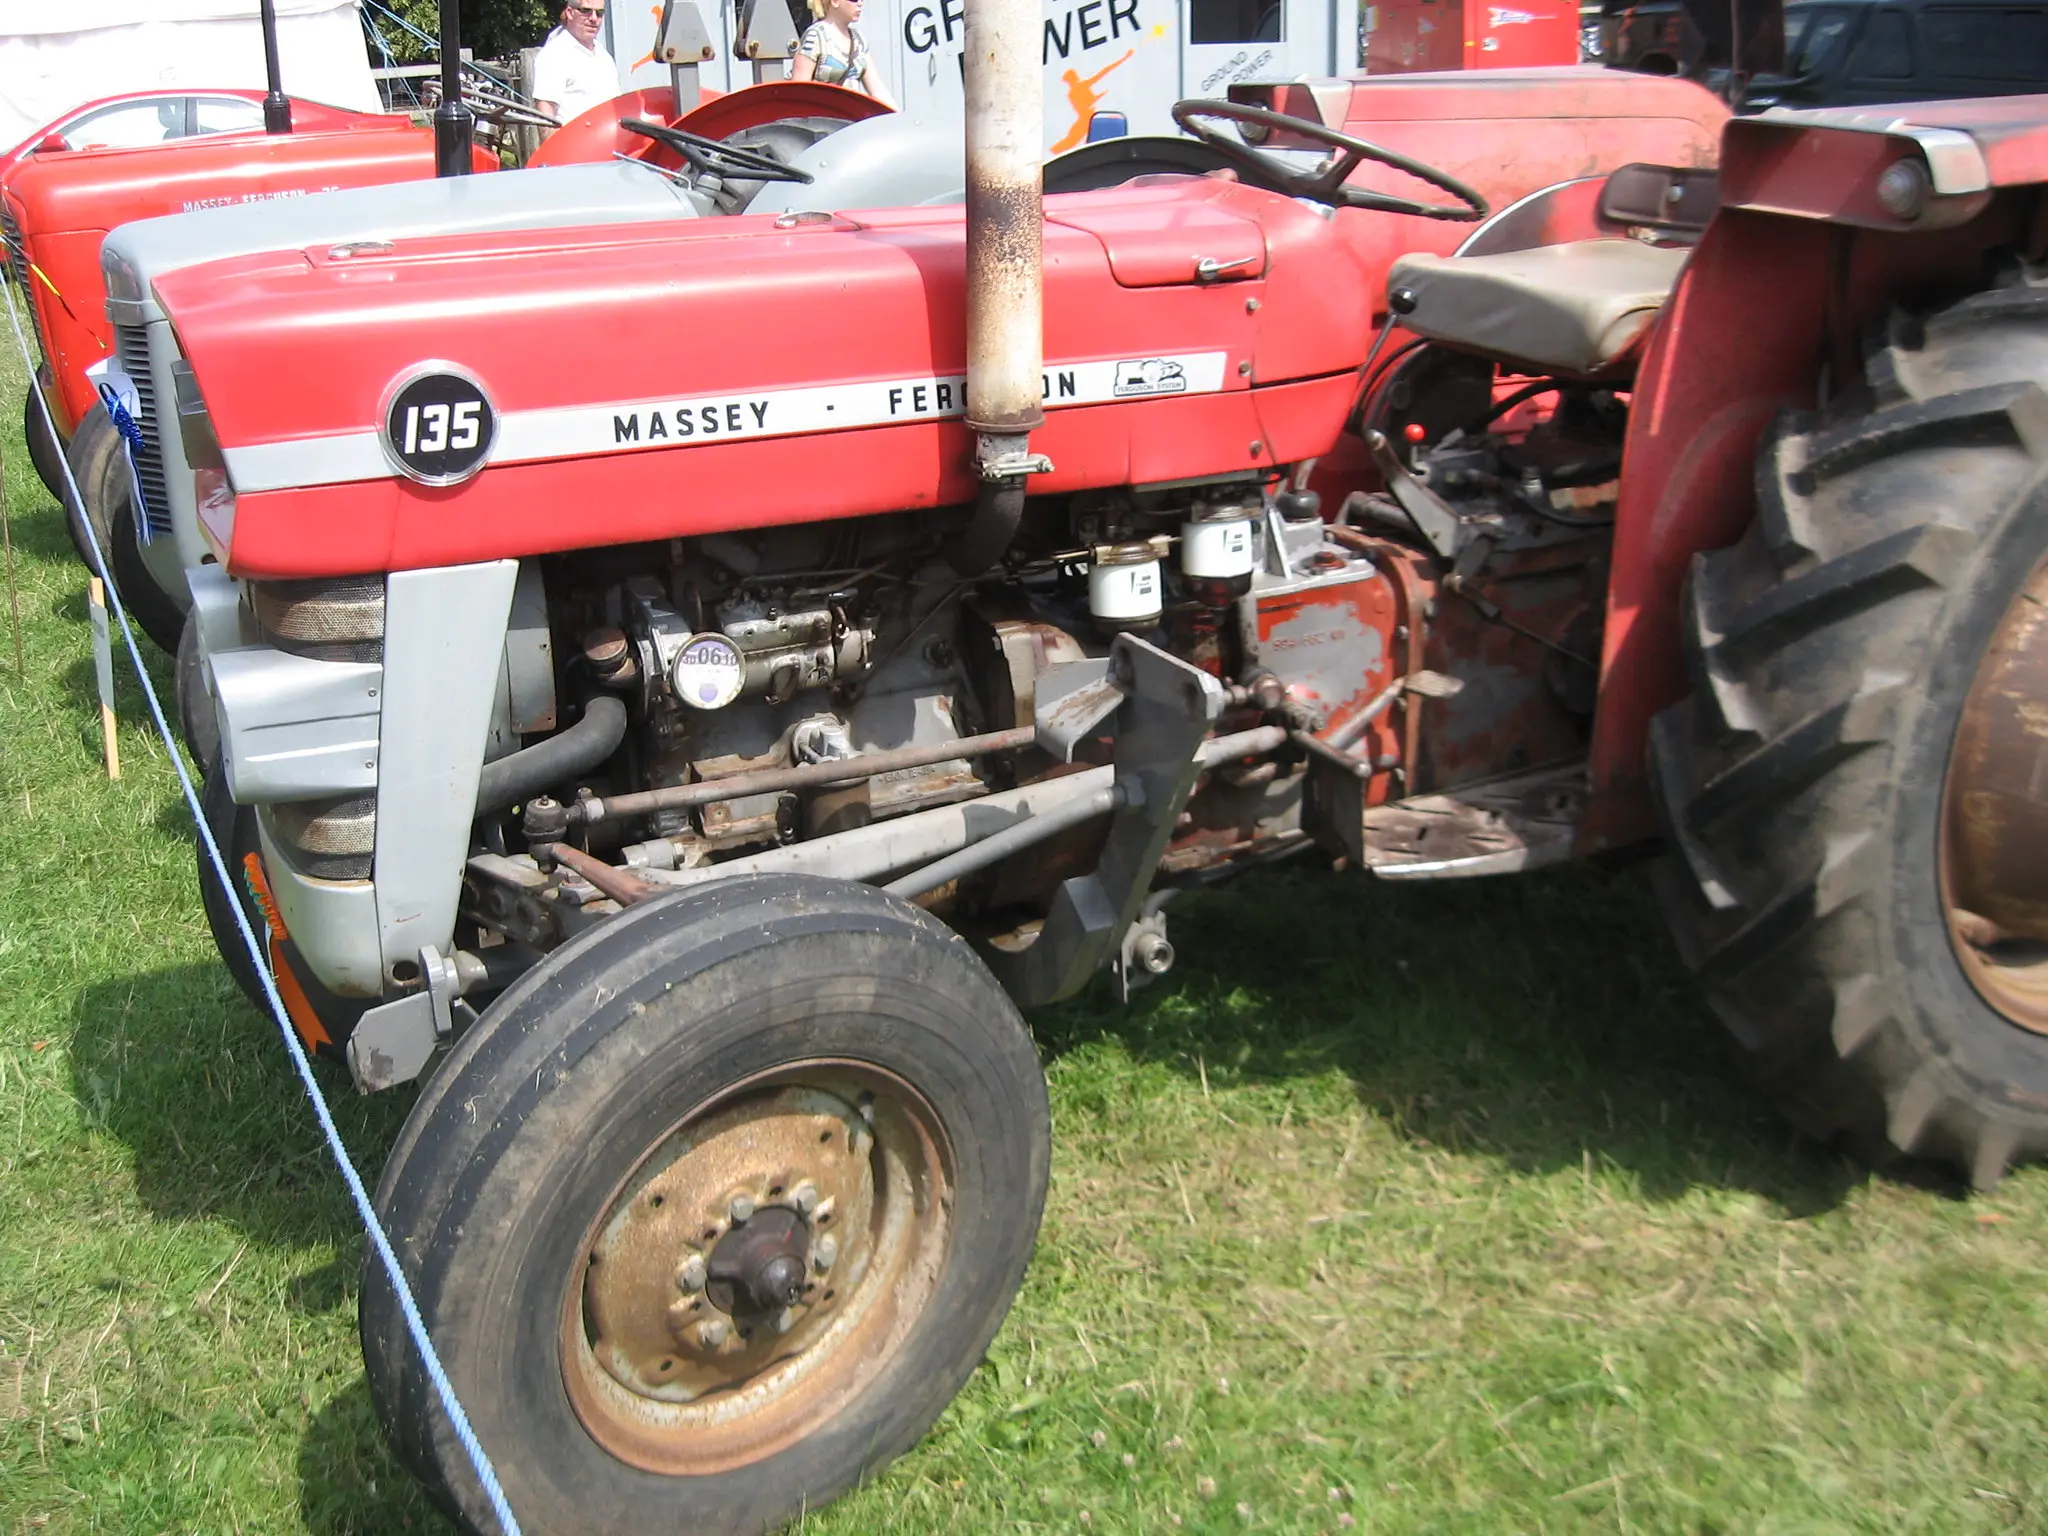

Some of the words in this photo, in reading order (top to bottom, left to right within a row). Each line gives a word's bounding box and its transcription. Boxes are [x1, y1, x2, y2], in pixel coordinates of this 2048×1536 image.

[1201, 51, 1248, 91] GROUND
[1232, 49, 1274, 83] POWER
[183, 196, 232, 213] MASSEY
[1117, 384, 1154, 393] FERGUSON
[1157, 382, 1182, 391] SYSTEM
[614, 401, 768, 443] MASSEY
[889, 371, 1076, 414] FERON
[404, 401, 482, 454] 135
[698, 647, 721, 665] 06
[723, 653, 738, 666] 10
